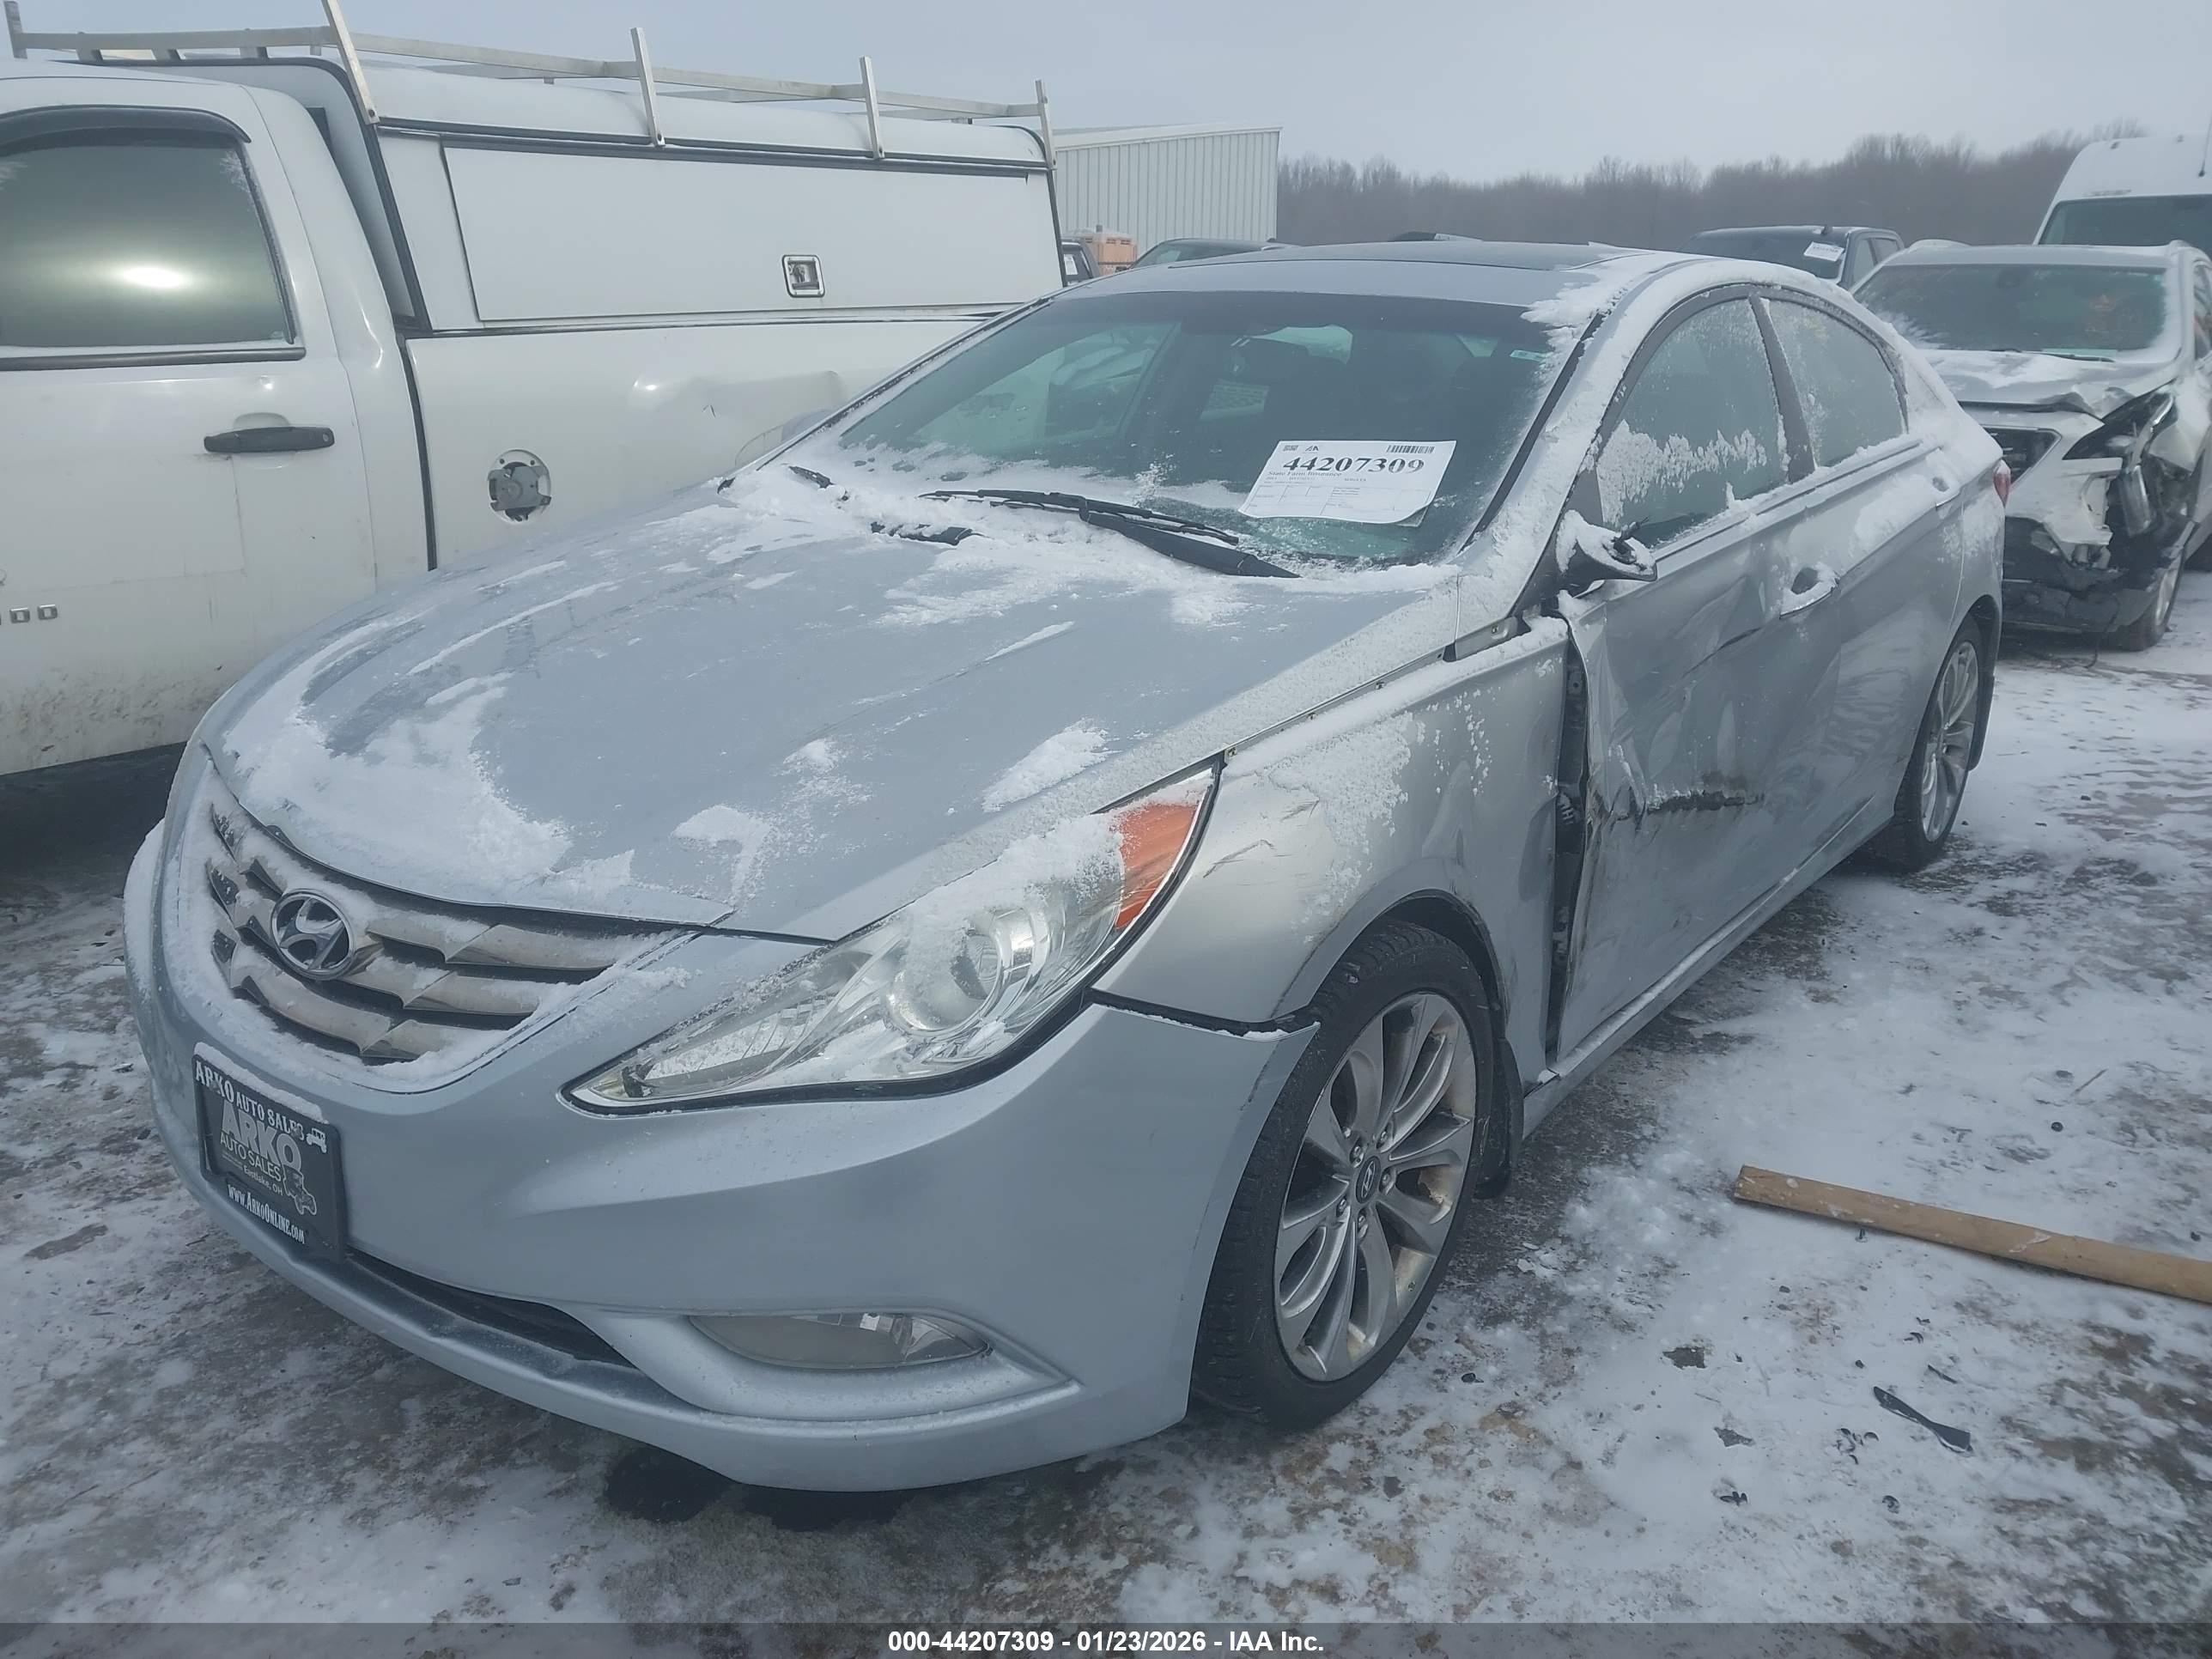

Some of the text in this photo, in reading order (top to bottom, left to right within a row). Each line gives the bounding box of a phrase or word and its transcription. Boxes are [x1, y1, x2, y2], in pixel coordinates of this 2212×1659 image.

[1283, 456, 1425, 474] 44207309
[222, 1100, 301, 1171] ARKO
[236, 1091, 265, 1121] AUTO
[267, 1109, 305, 1141] SALES
[221, 1131, 246, 1160] AUTO
[247, 1150, 282, 1182] SALES
[272, 1183, 283, 1196] OH
